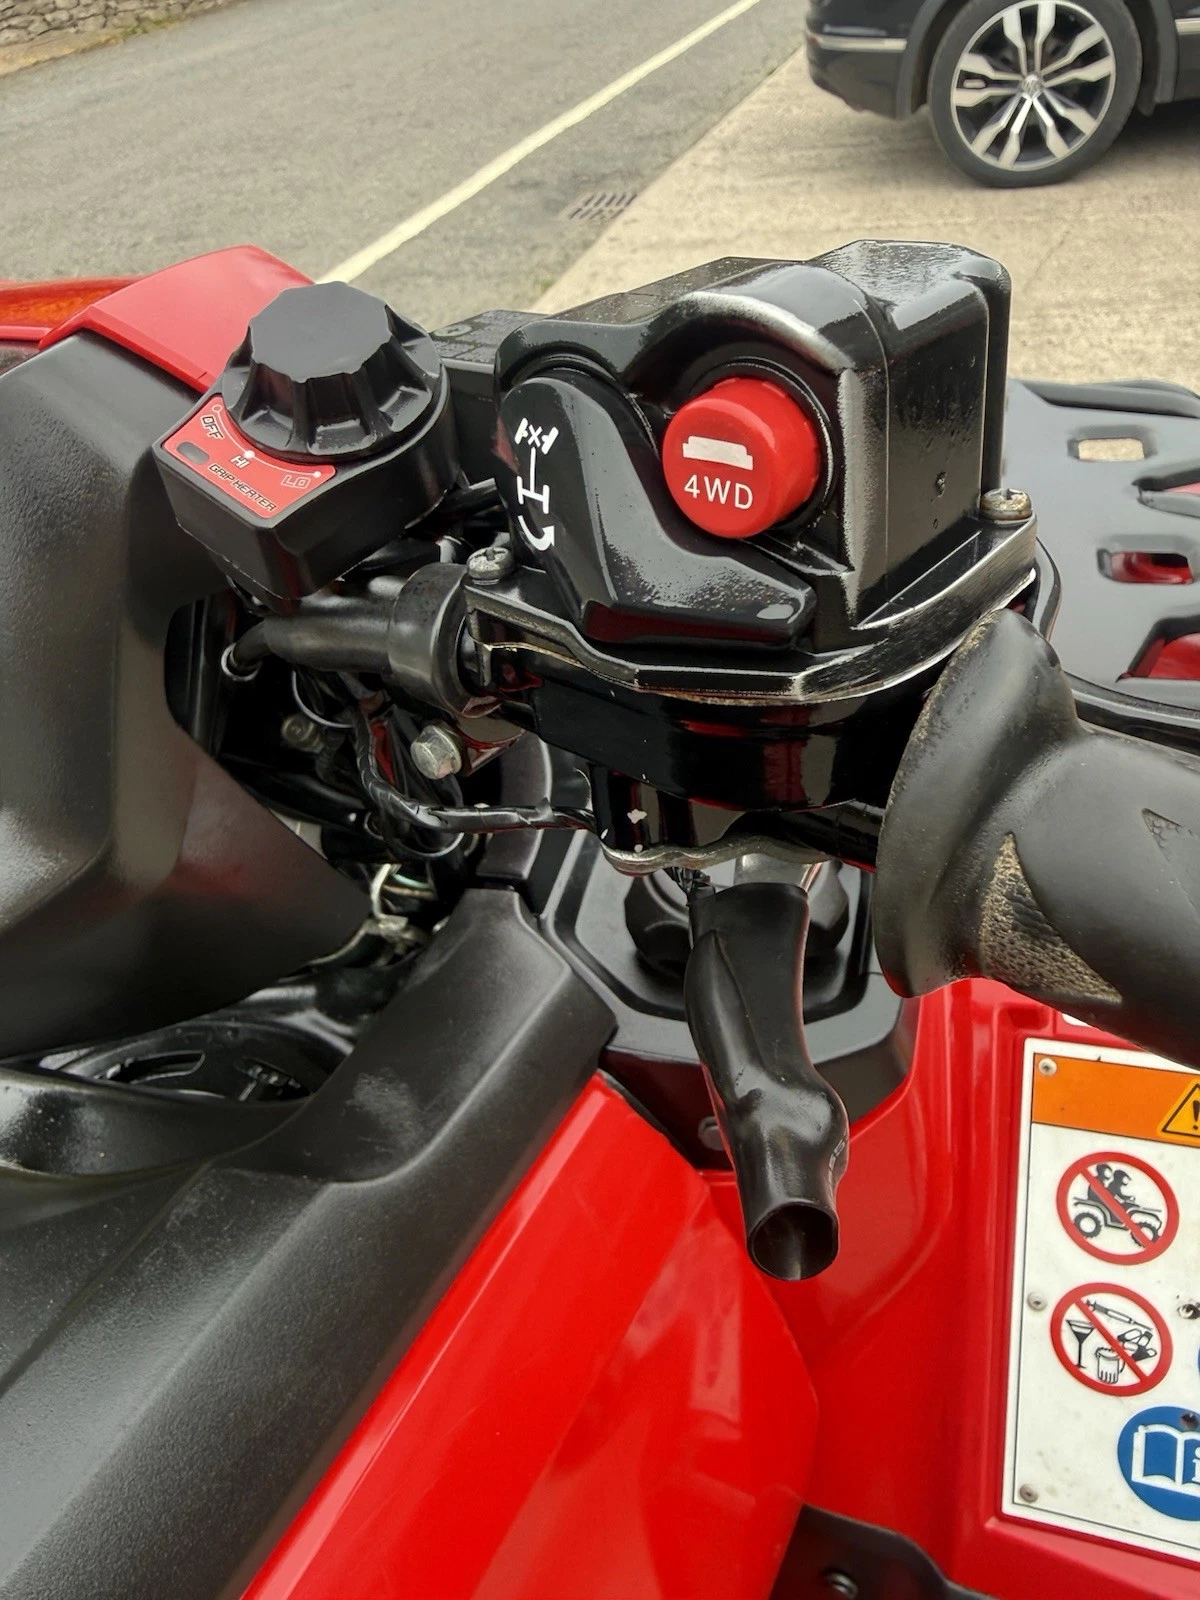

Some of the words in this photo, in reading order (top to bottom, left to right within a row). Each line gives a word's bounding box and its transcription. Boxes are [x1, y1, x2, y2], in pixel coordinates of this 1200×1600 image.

[201, 416, 224, 439] OFF
[230, 455, 249, 468] HI
[209, 464, 234, 484] GRIP
[232, 480, 276, 511] HEATER
[281, 475, 311, 488] LO
[684, 474, 753, 510] 4WD
